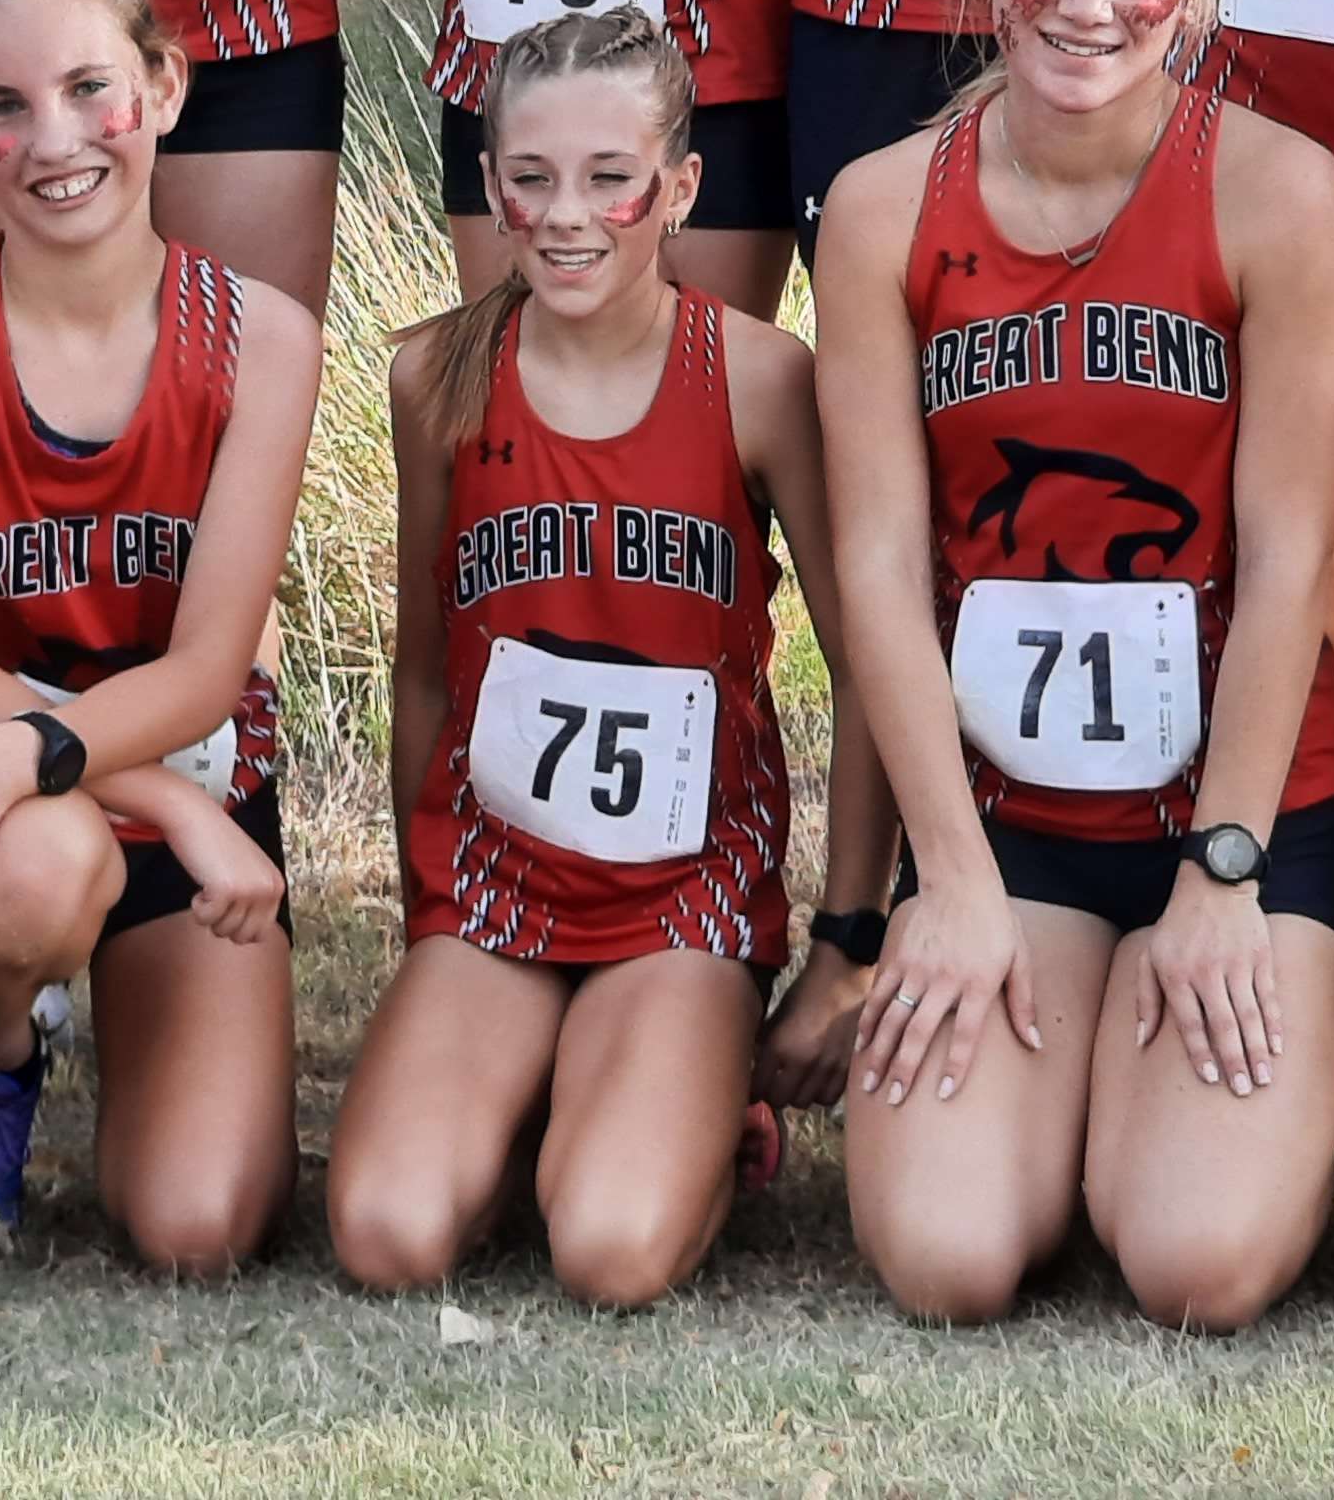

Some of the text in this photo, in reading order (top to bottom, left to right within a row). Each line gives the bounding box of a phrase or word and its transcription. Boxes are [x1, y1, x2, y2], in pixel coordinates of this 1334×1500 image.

[1084, 302, 1229, 404] BEND
[454, 501, 736, 610] GREAT BEND
[1017, 629, 1125, 742] 71
[531, 698, 650, 818] 75
